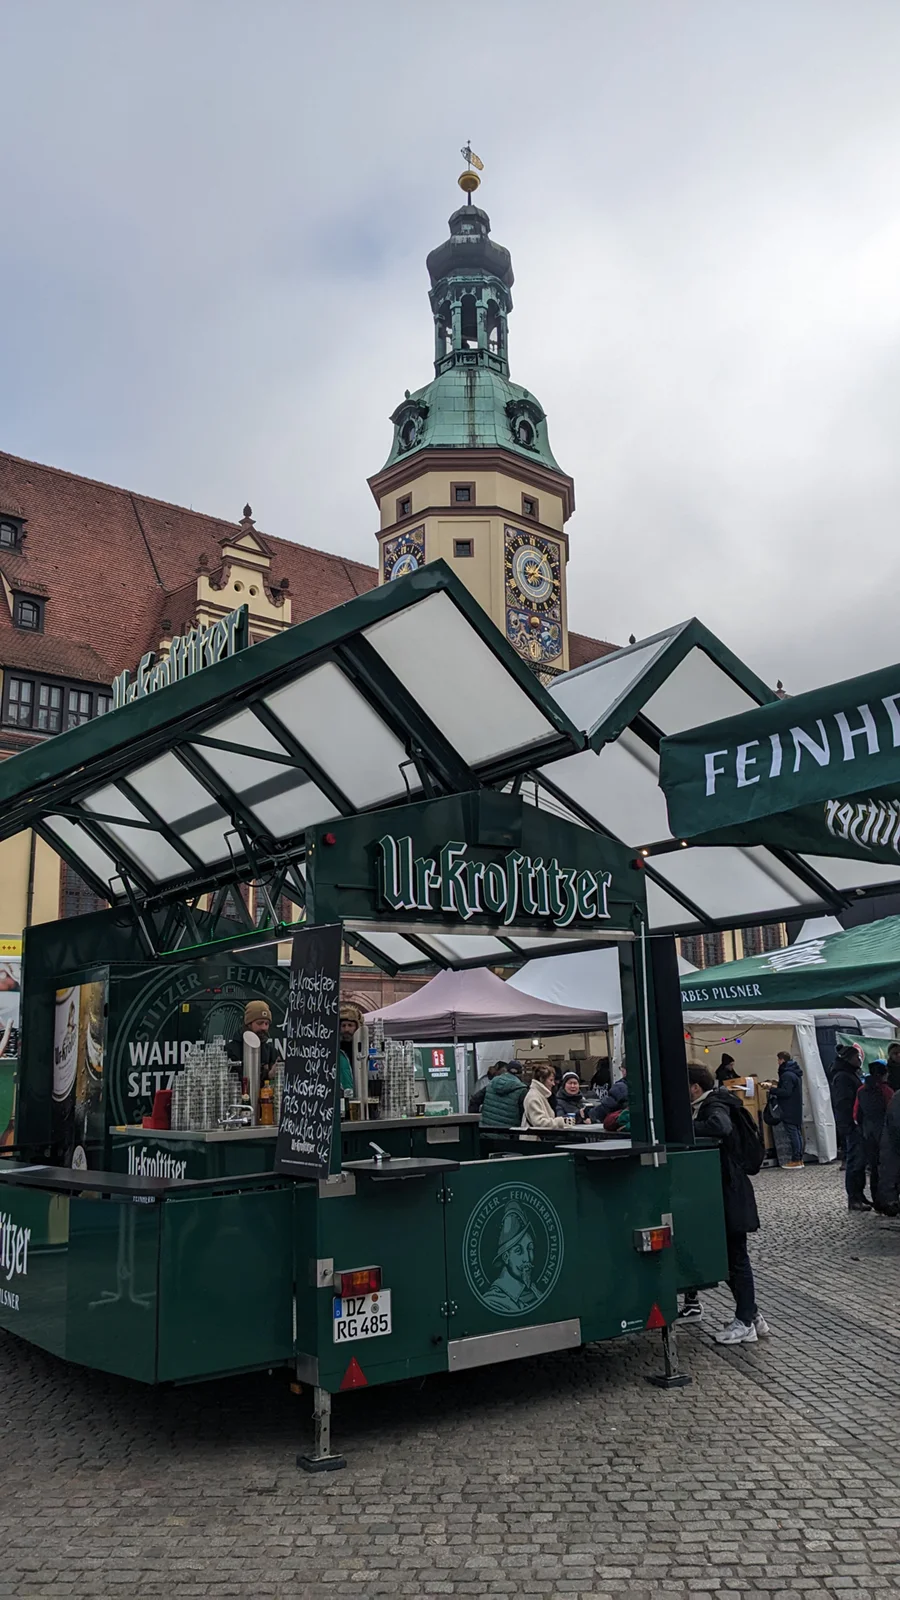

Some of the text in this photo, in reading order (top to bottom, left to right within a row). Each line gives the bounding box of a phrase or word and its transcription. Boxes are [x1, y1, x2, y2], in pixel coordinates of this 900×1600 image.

[712, 983, 762, 1000] PILSNER
[510, 1190, 556, 1232] FEINHERBES
[542, 1235, 558, 1285] PILSNER
[346, 1296, 366, 1317] DZ
[337, 1314, 388, 1340] RG 485
